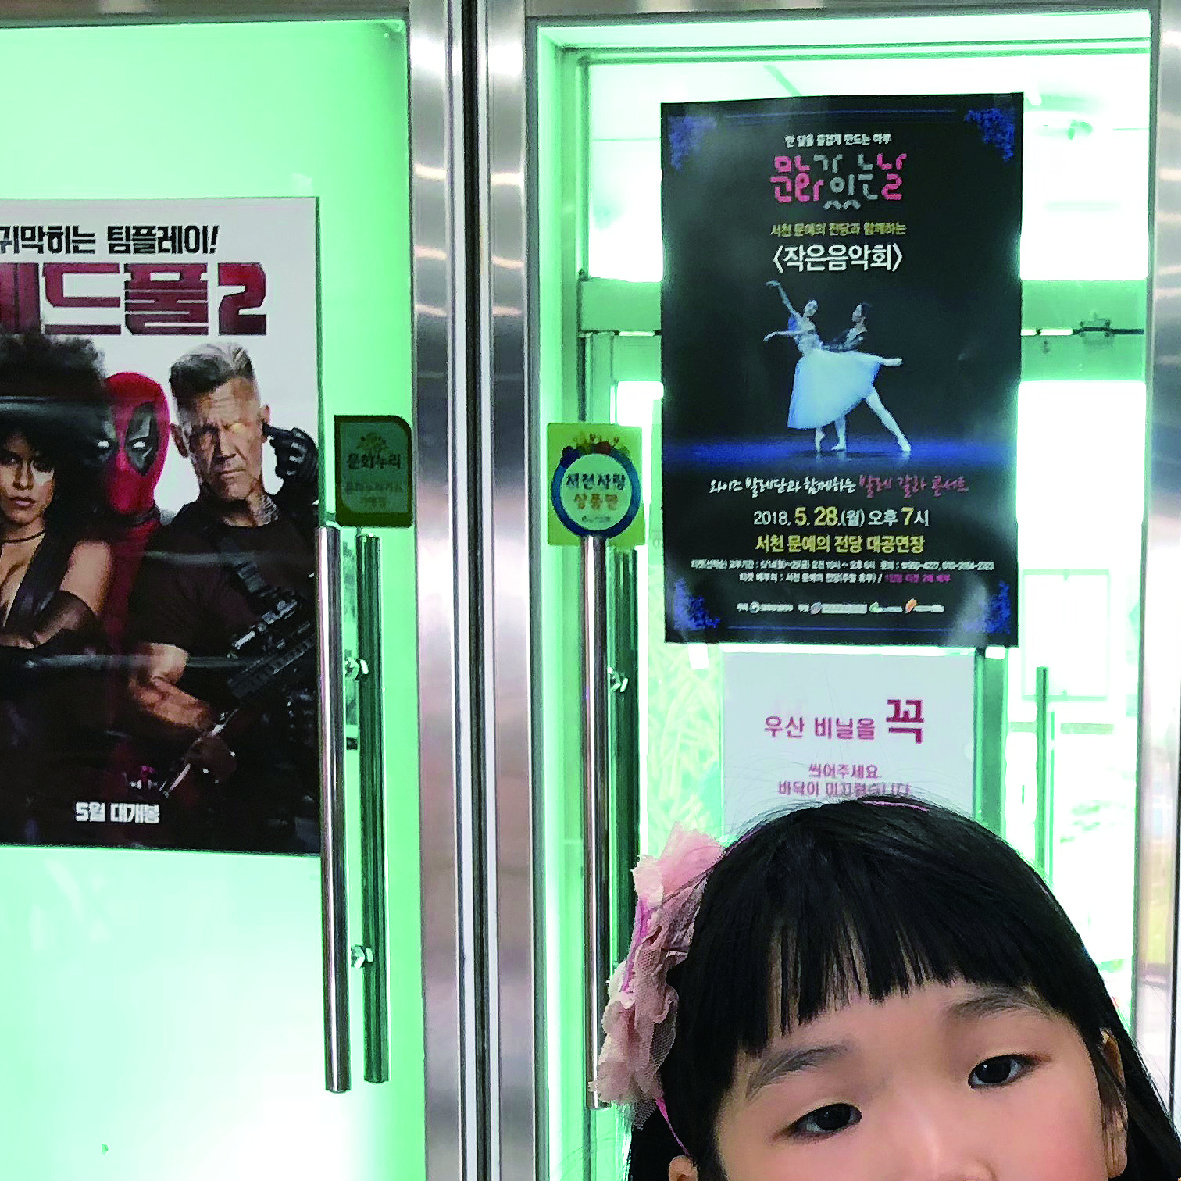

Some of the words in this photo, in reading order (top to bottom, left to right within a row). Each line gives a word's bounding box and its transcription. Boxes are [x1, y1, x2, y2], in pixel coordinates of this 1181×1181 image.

[107, 224, 220, 255] 팀플레이!
[770, 223, 792, 237] 서천
[868, 509, 898, 528] 오후
[901, 507, 930, 527] 7시
[755, 534, 784, 553] 서천
[787, 534, 831, 553] 문예의
[834, 534, 863, 553] 전당
[866, 534, 925, 554] 대공연장
[764, 715, 805, 739] 우산
[814, 716, 876, 741] 비닐을
[886, 699, 925, 744] 꼭
[778, 780, 820, 797] 바닥이
[75, 801, 106, 823] 5월
[109, 802, 160, 824] 대개봉
